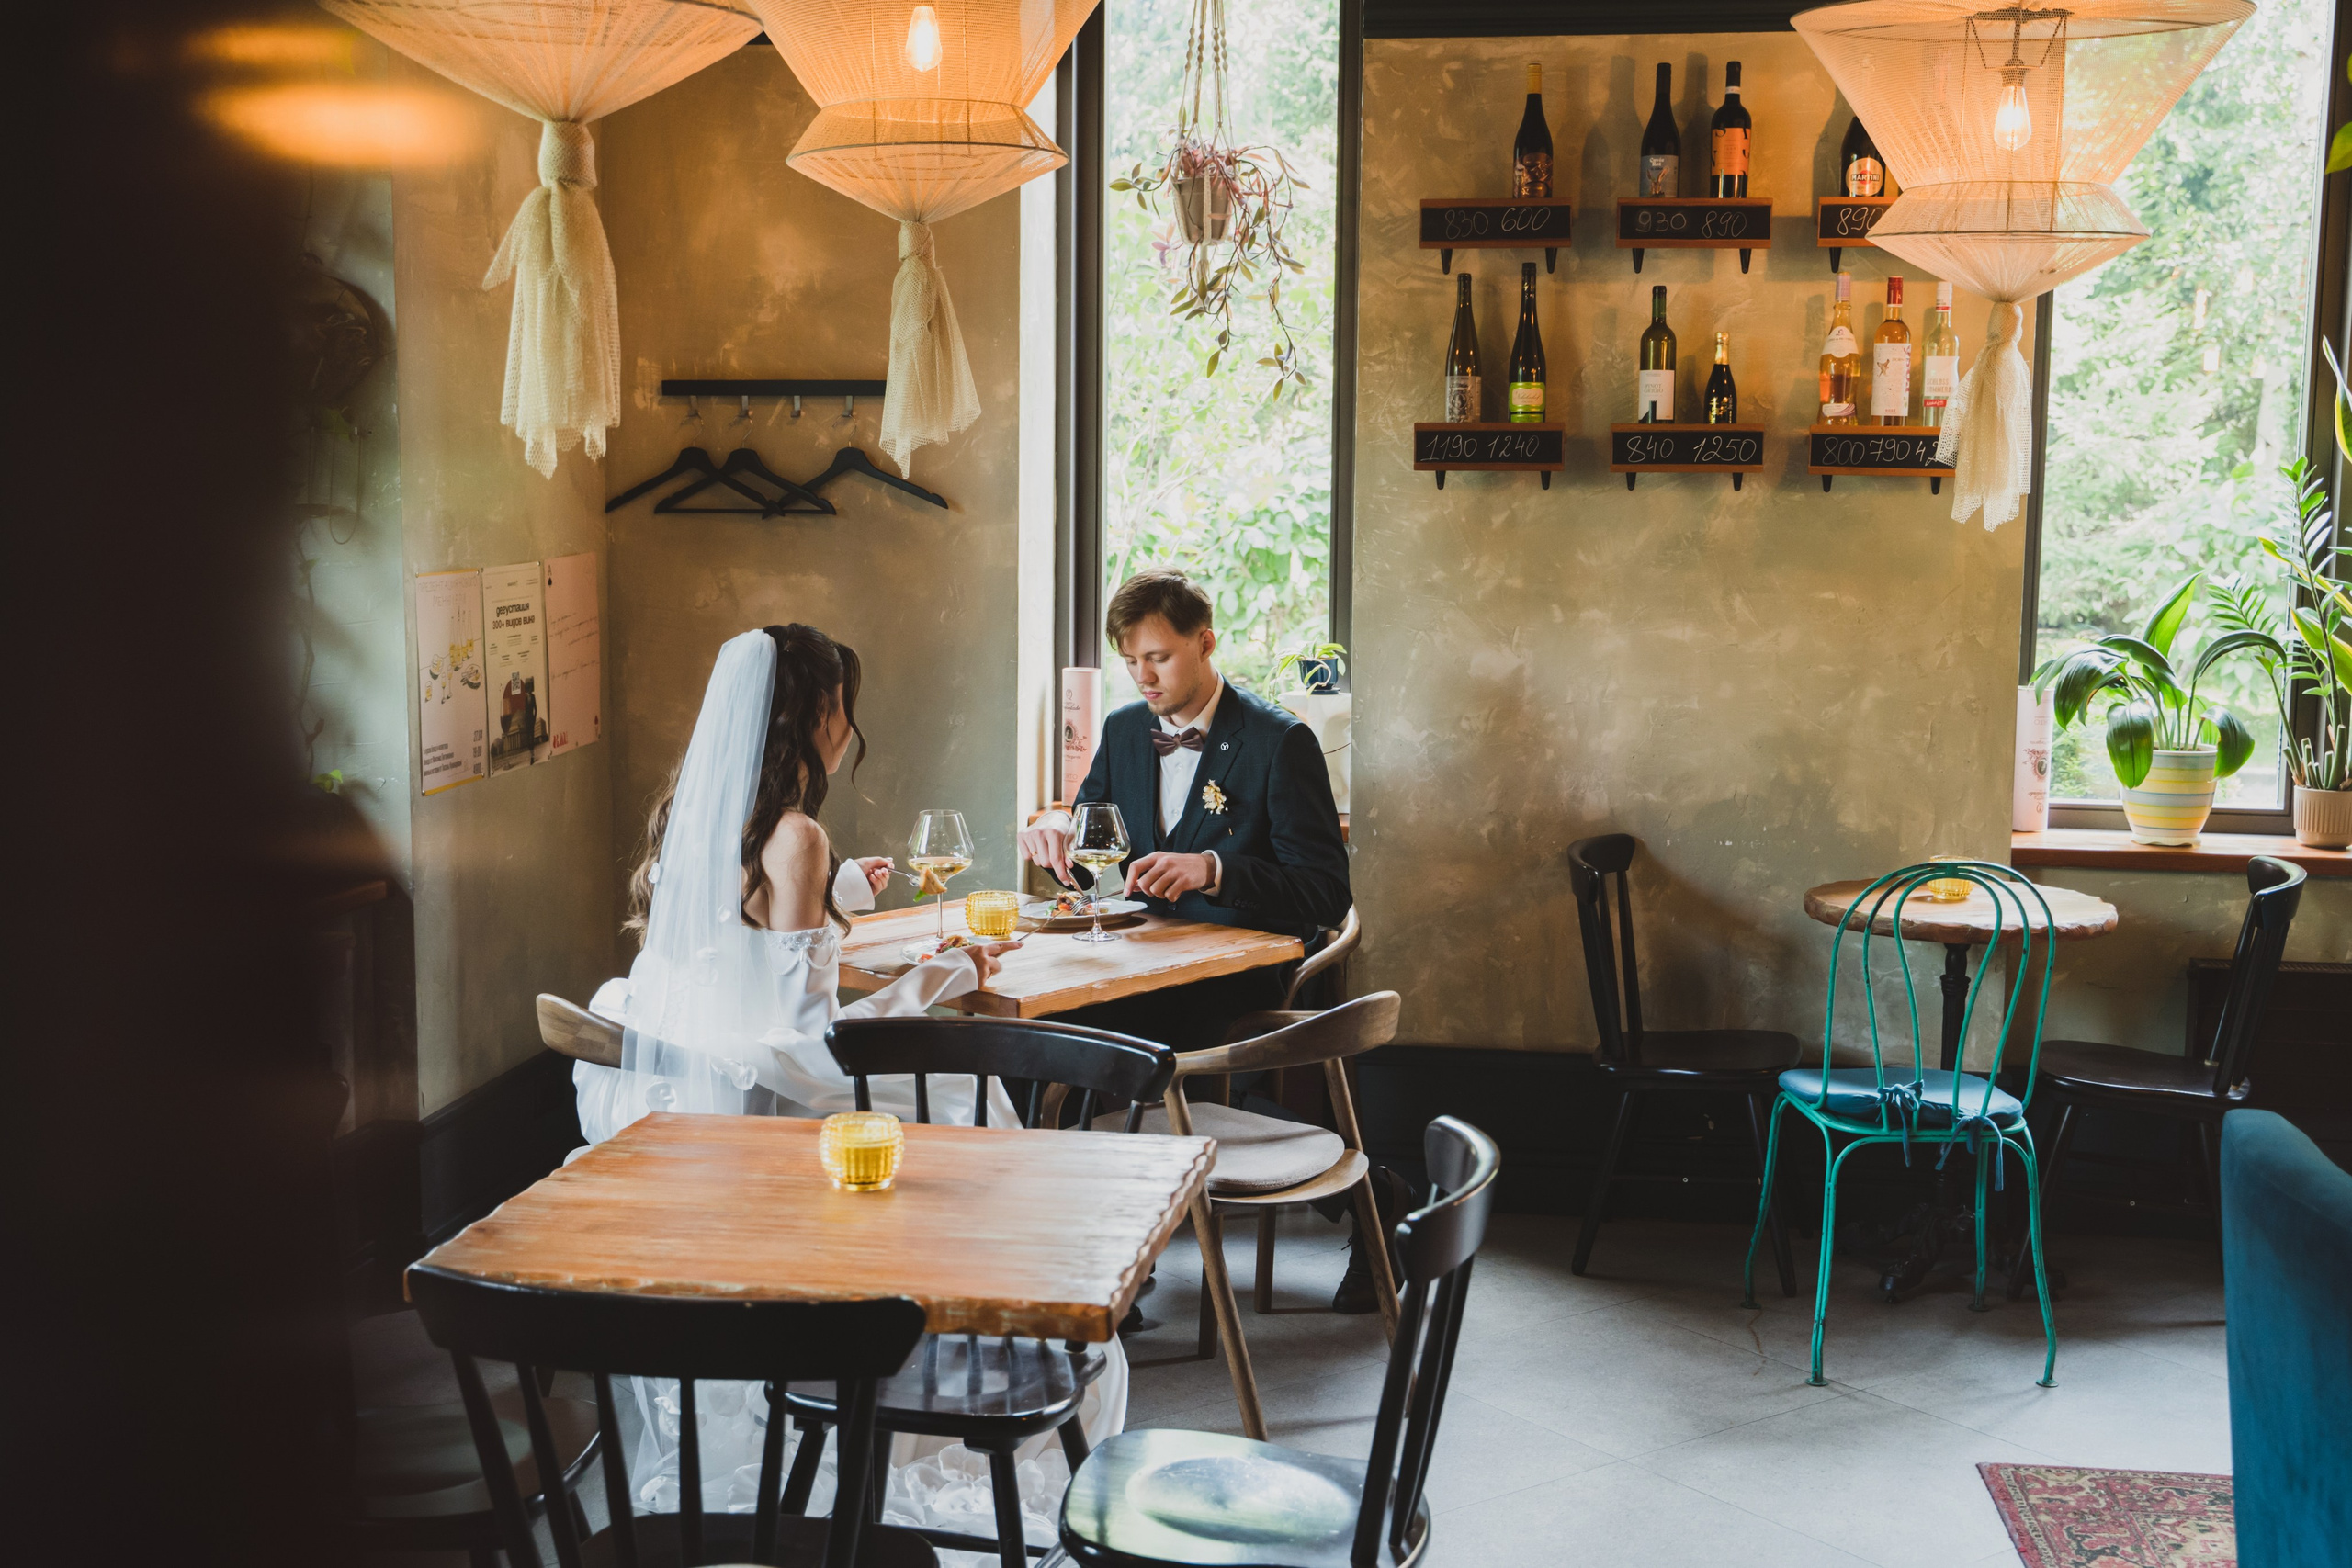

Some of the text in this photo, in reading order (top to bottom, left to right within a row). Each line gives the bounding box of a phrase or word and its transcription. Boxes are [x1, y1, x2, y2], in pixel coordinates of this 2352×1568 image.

[1445, 207, 1551, 240] 830 600
[1635, 210, 1747, 239] 930 890
[1837, 206, 1884, 236] 890
[1420, 434, 1540, 462] 1190 1240
[1626, 435, 1757, 463] 840 1250
[1822, 436, 1866, 466] 800
[1869, 437, 1911, 462] 790
[492, 619, 505, 630] 300+
